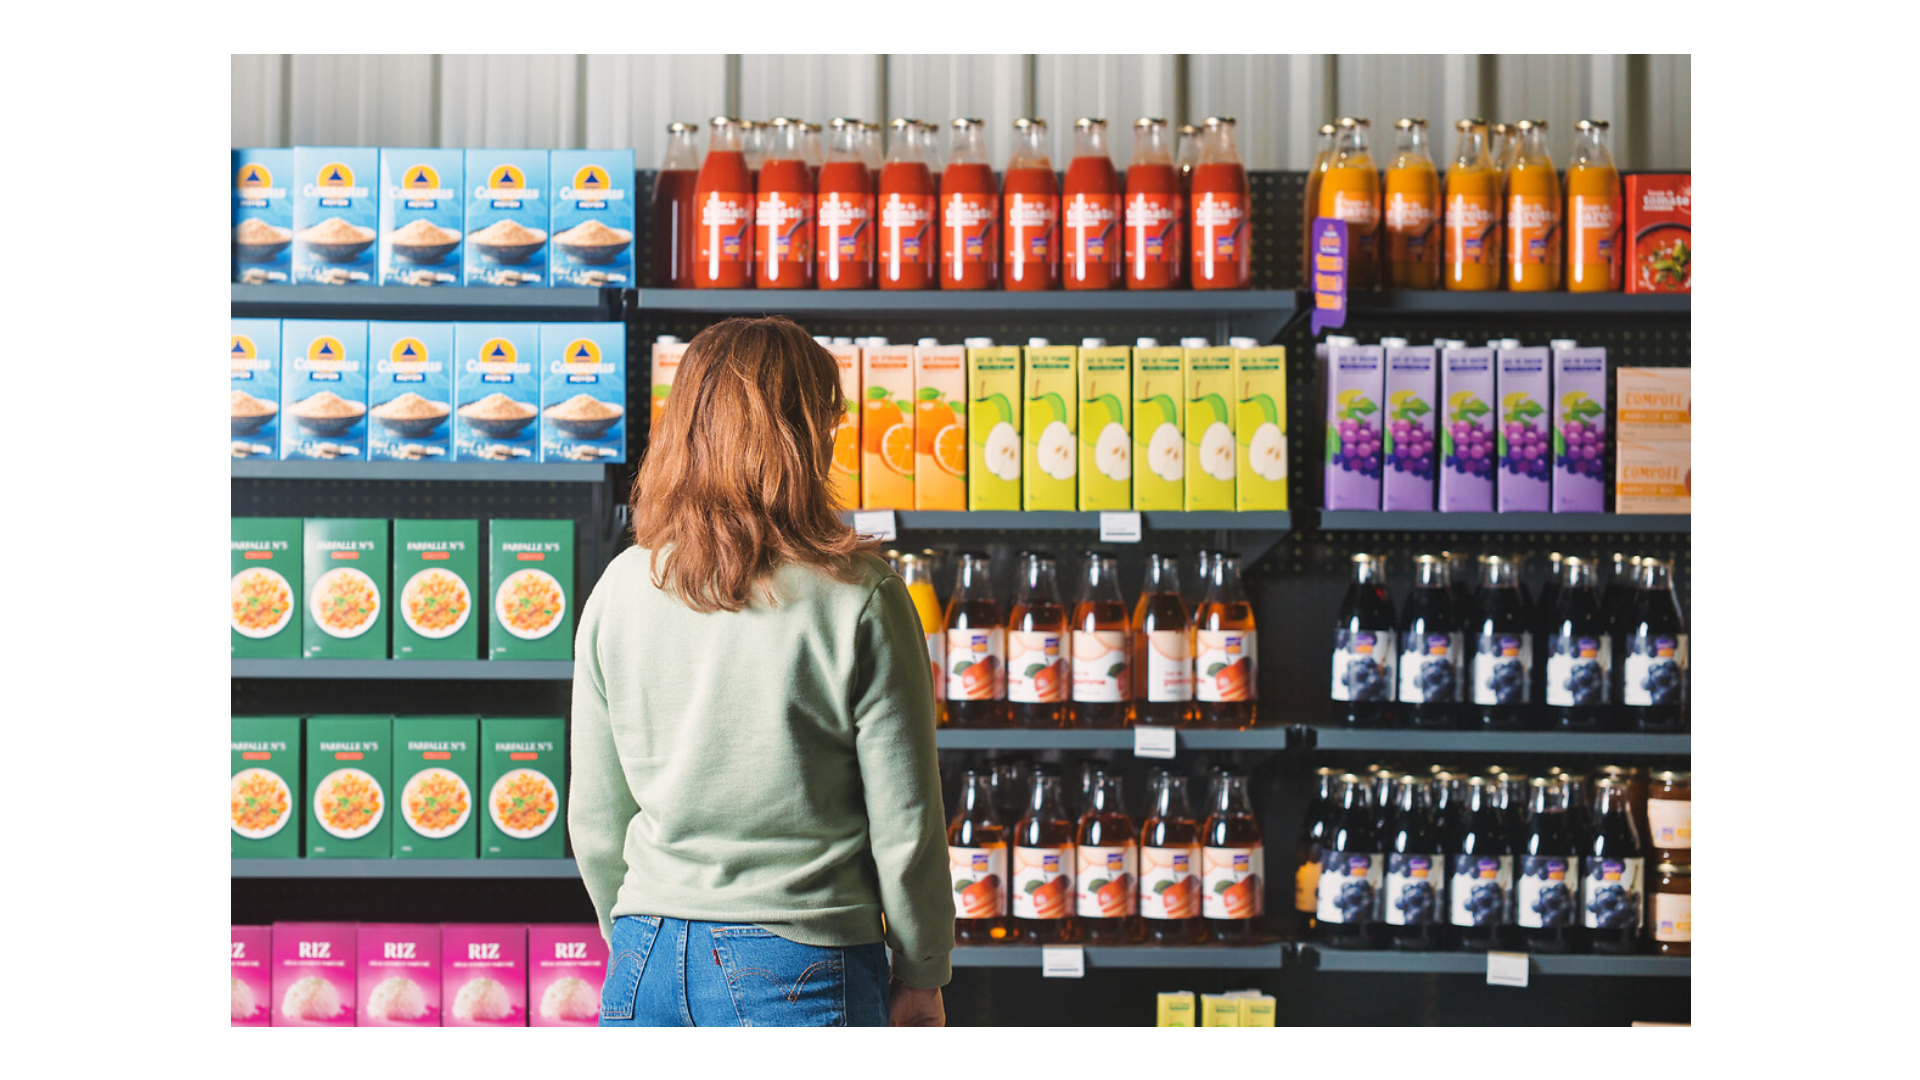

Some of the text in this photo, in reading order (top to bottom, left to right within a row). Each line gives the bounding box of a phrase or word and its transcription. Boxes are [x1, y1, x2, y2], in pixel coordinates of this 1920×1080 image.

[231, 359, 271, 372] scous
[299, 942, 330, 958] RIZ
[384, 942, 416, 959] RIZ
[468, 943, 500, 959] RIZ
[555, 942, 587, 959] RIZ
